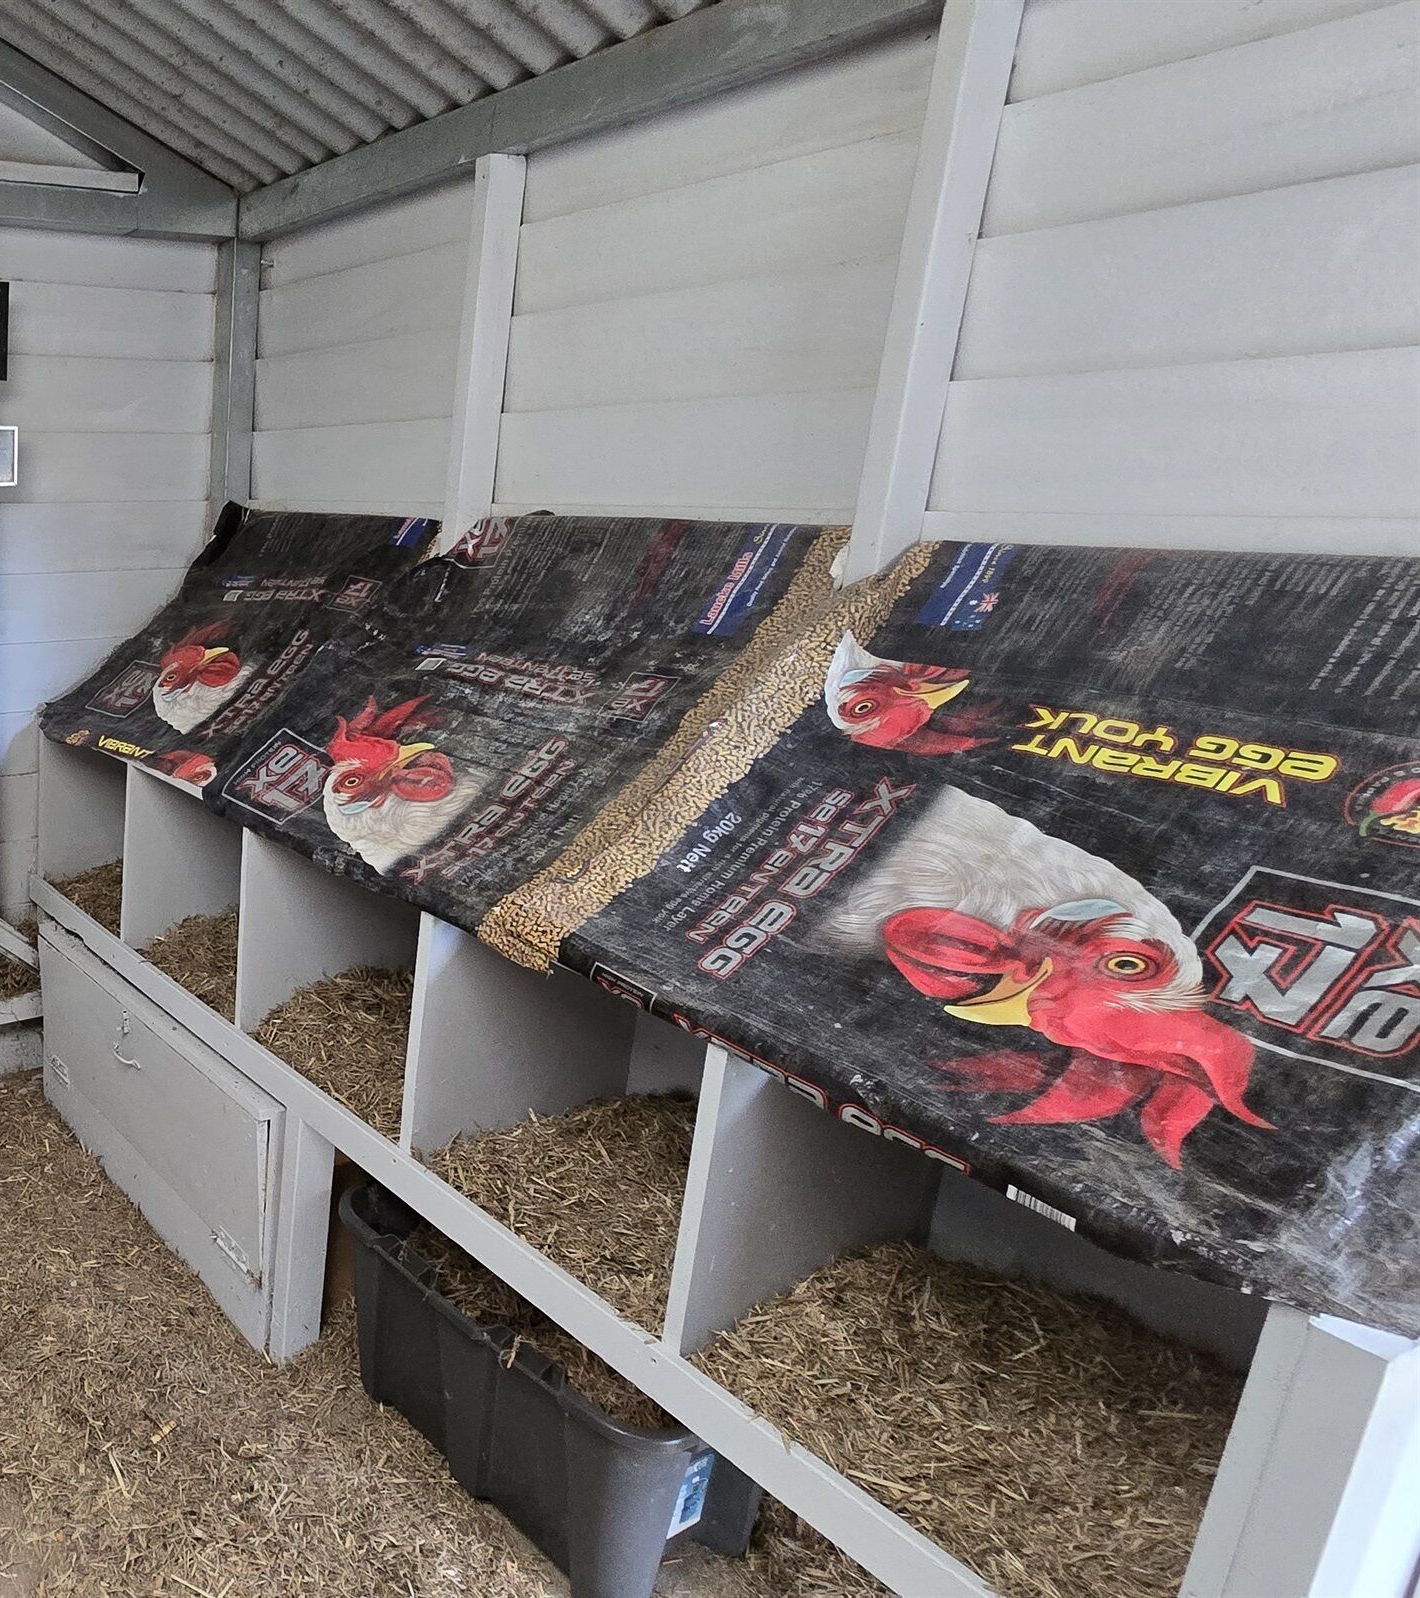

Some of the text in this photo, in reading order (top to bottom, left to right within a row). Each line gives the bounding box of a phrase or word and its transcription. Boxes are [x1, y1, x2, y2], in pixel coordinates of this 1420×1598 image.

[1018, 703, 1178, 754] YOLK
[761, 798, 800, 838] Protein
[675, 810, 742, 874] 20kg Nett
[720, 835, 766, 881] Premium
[690, 878, 725, 908] Home
[663, 905, 695, 933] Layer
